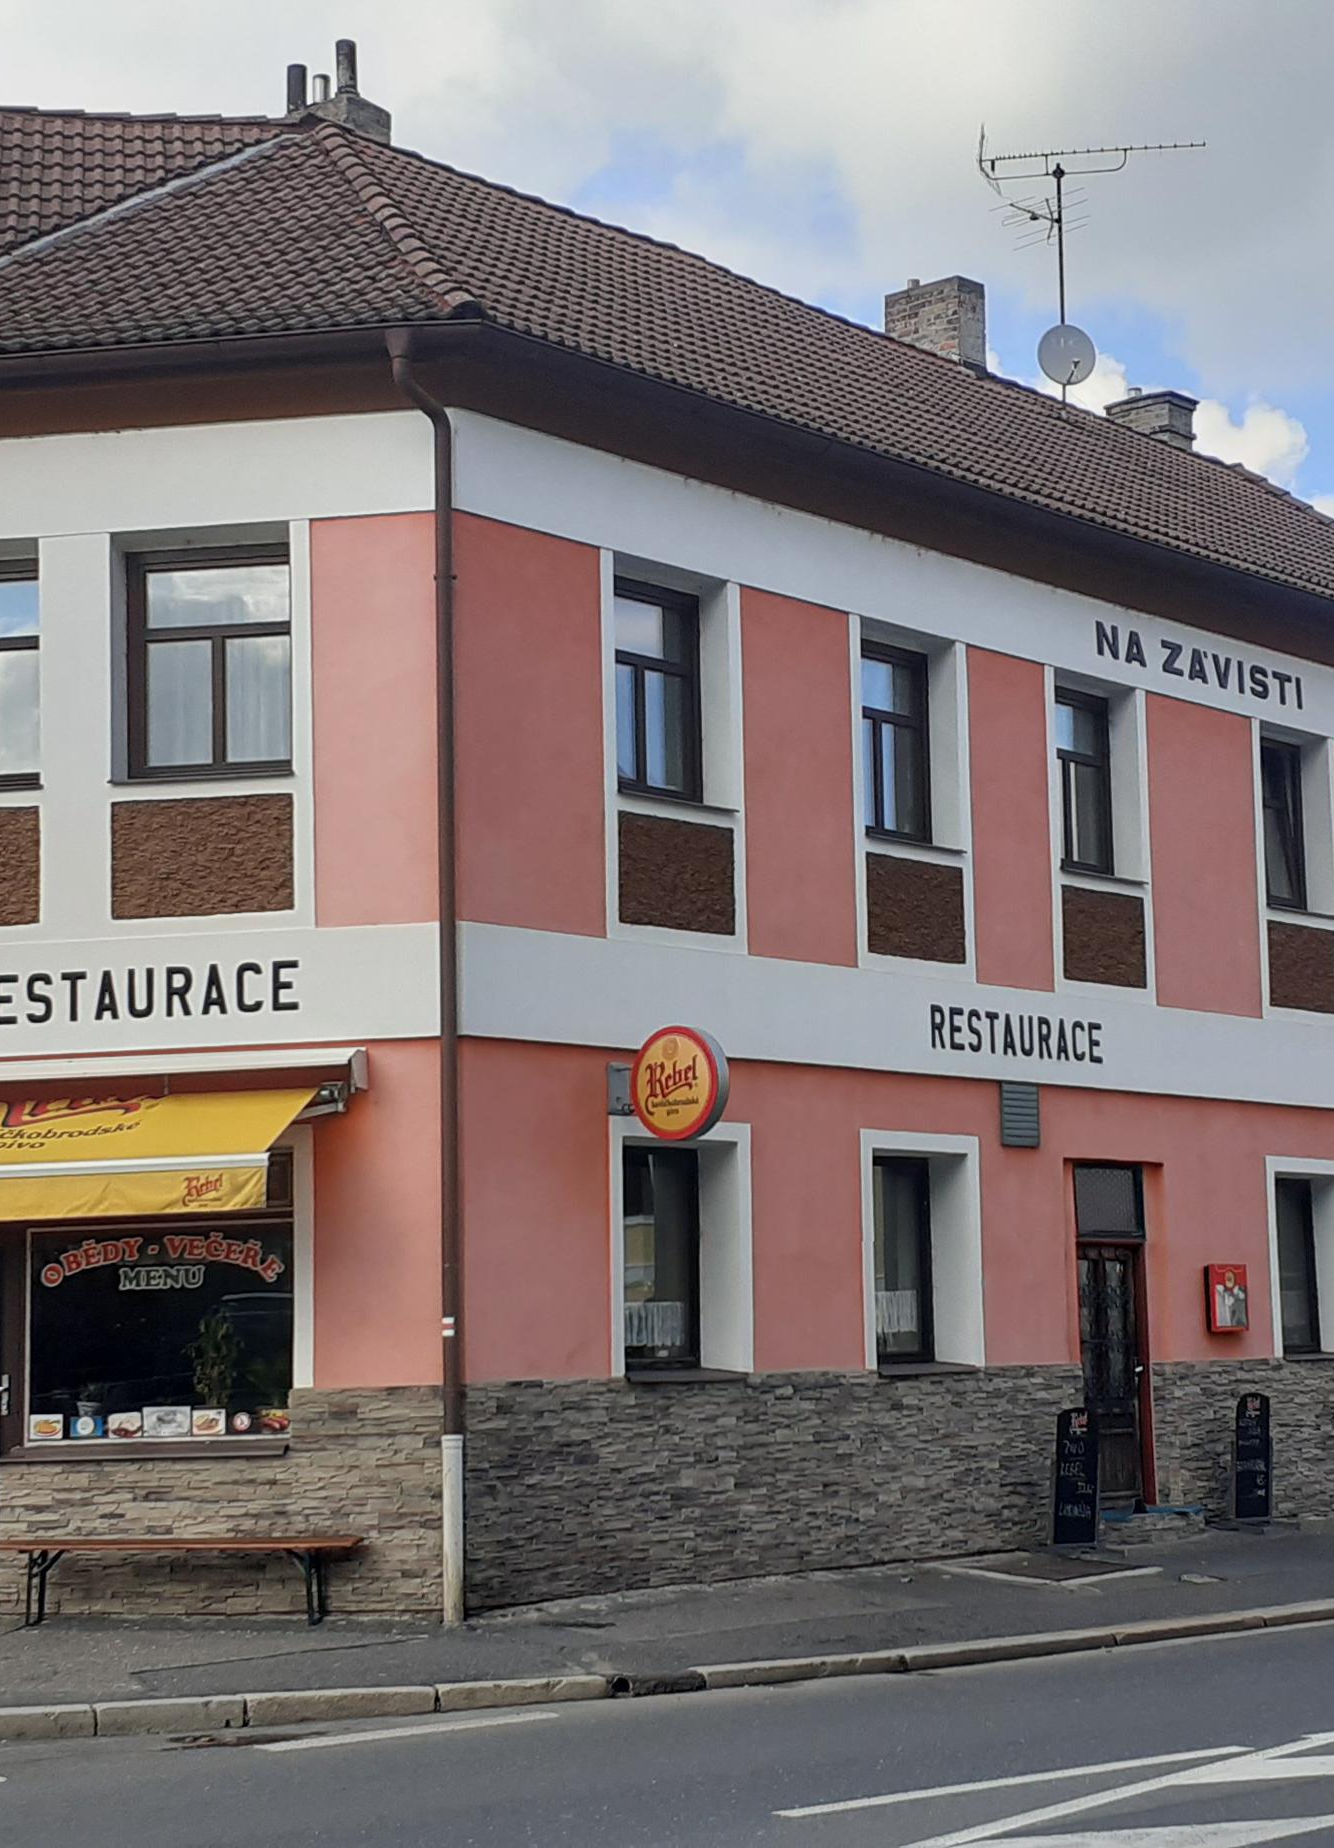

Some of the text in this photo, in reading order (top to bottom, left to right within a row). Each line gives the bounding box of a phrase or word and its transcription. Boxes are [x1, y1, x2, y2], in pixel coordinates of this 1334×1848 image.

[1095, 620, 1303, 710] NA ZÁVISTI
[930, 1003, 1104, 1065] RESTAURACE
[645, 1054, 699, 1102] Rebel
[41, 1237, 143, 1287] OBĚDY
[163, 1232, 286, 1282] VEČEŘE
[119, 1266, 205, 1290] MENU
